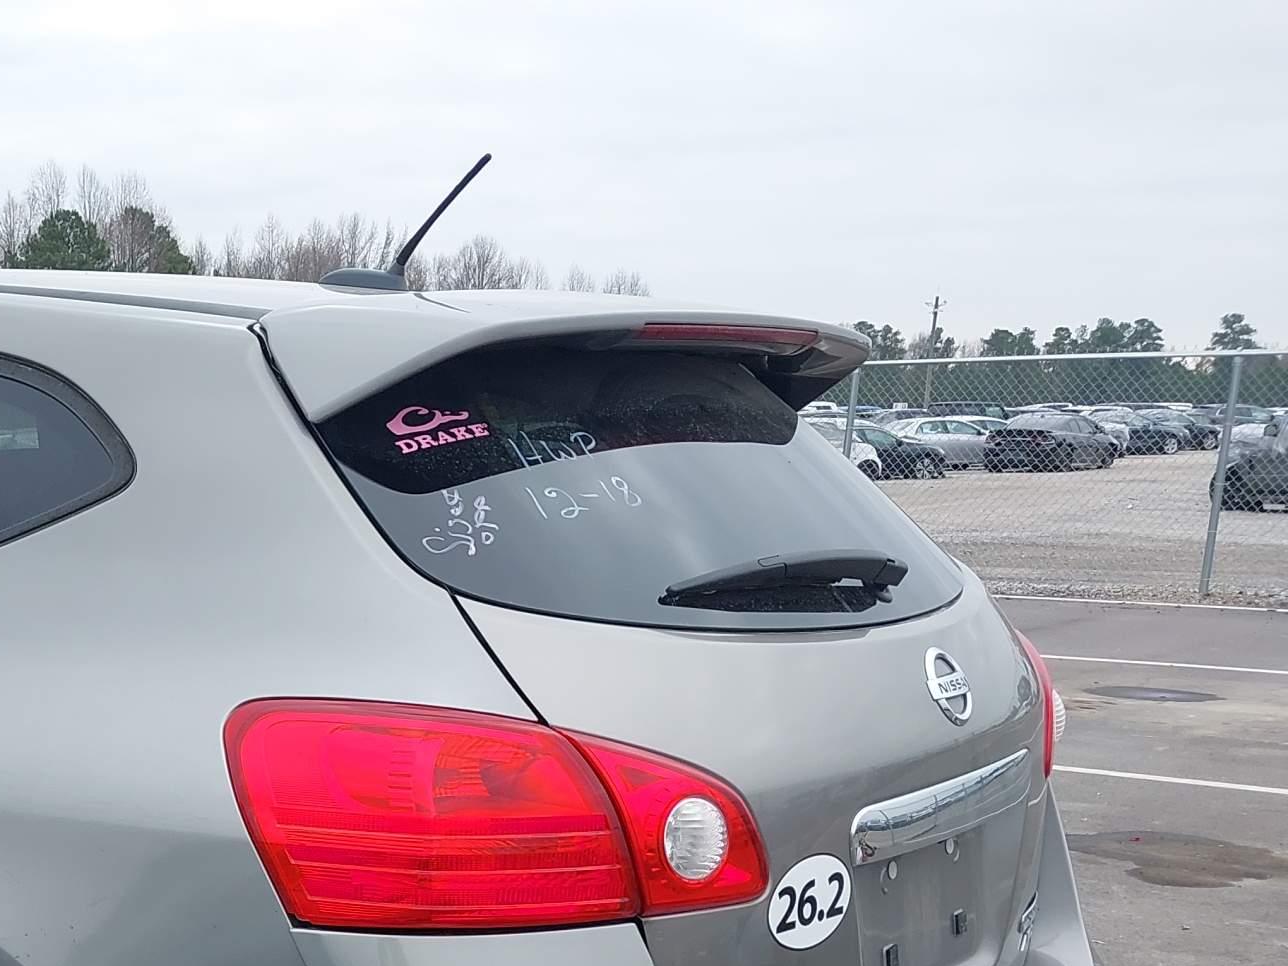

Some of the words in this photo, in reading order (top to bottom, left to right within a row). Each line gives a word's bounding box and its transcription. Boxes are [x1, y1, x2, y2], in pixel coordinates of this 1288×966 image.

[395, 422, 489, 454] DRAKE
[525, 475, 642, 519] 12-18
[938, 676, 969, 694] NISSA
[775, 871, 845, 934] 26.2
